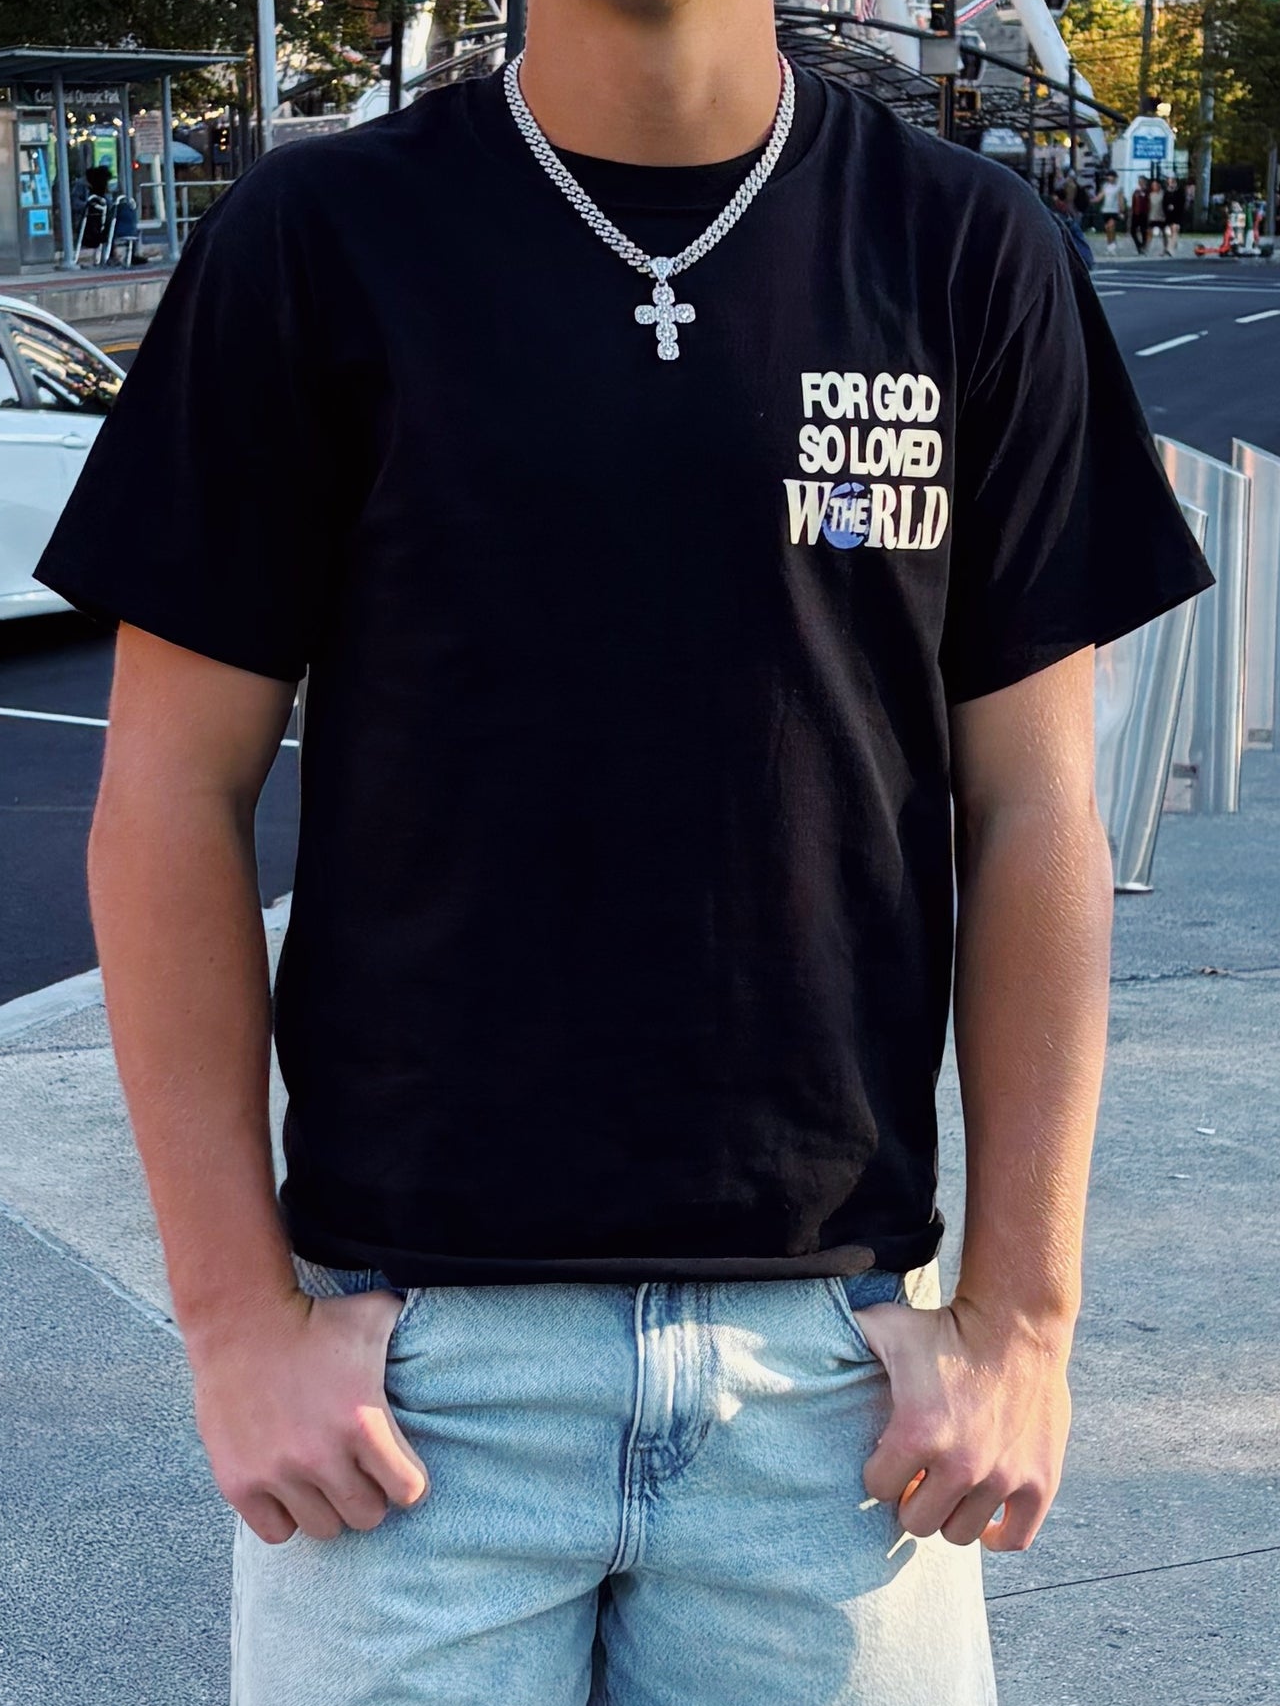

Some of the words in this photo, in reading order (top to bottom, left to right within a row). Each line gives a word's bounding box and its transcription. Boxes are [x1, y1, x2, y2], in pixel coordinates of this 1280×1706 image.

[801, 371, 869, 420] FOR
[872, 372, 941, 423] GOD
[798, 424, 846, 474] SO
[849, 426, 943, 478] LOVED
[828, 496, 871, 534] THE
